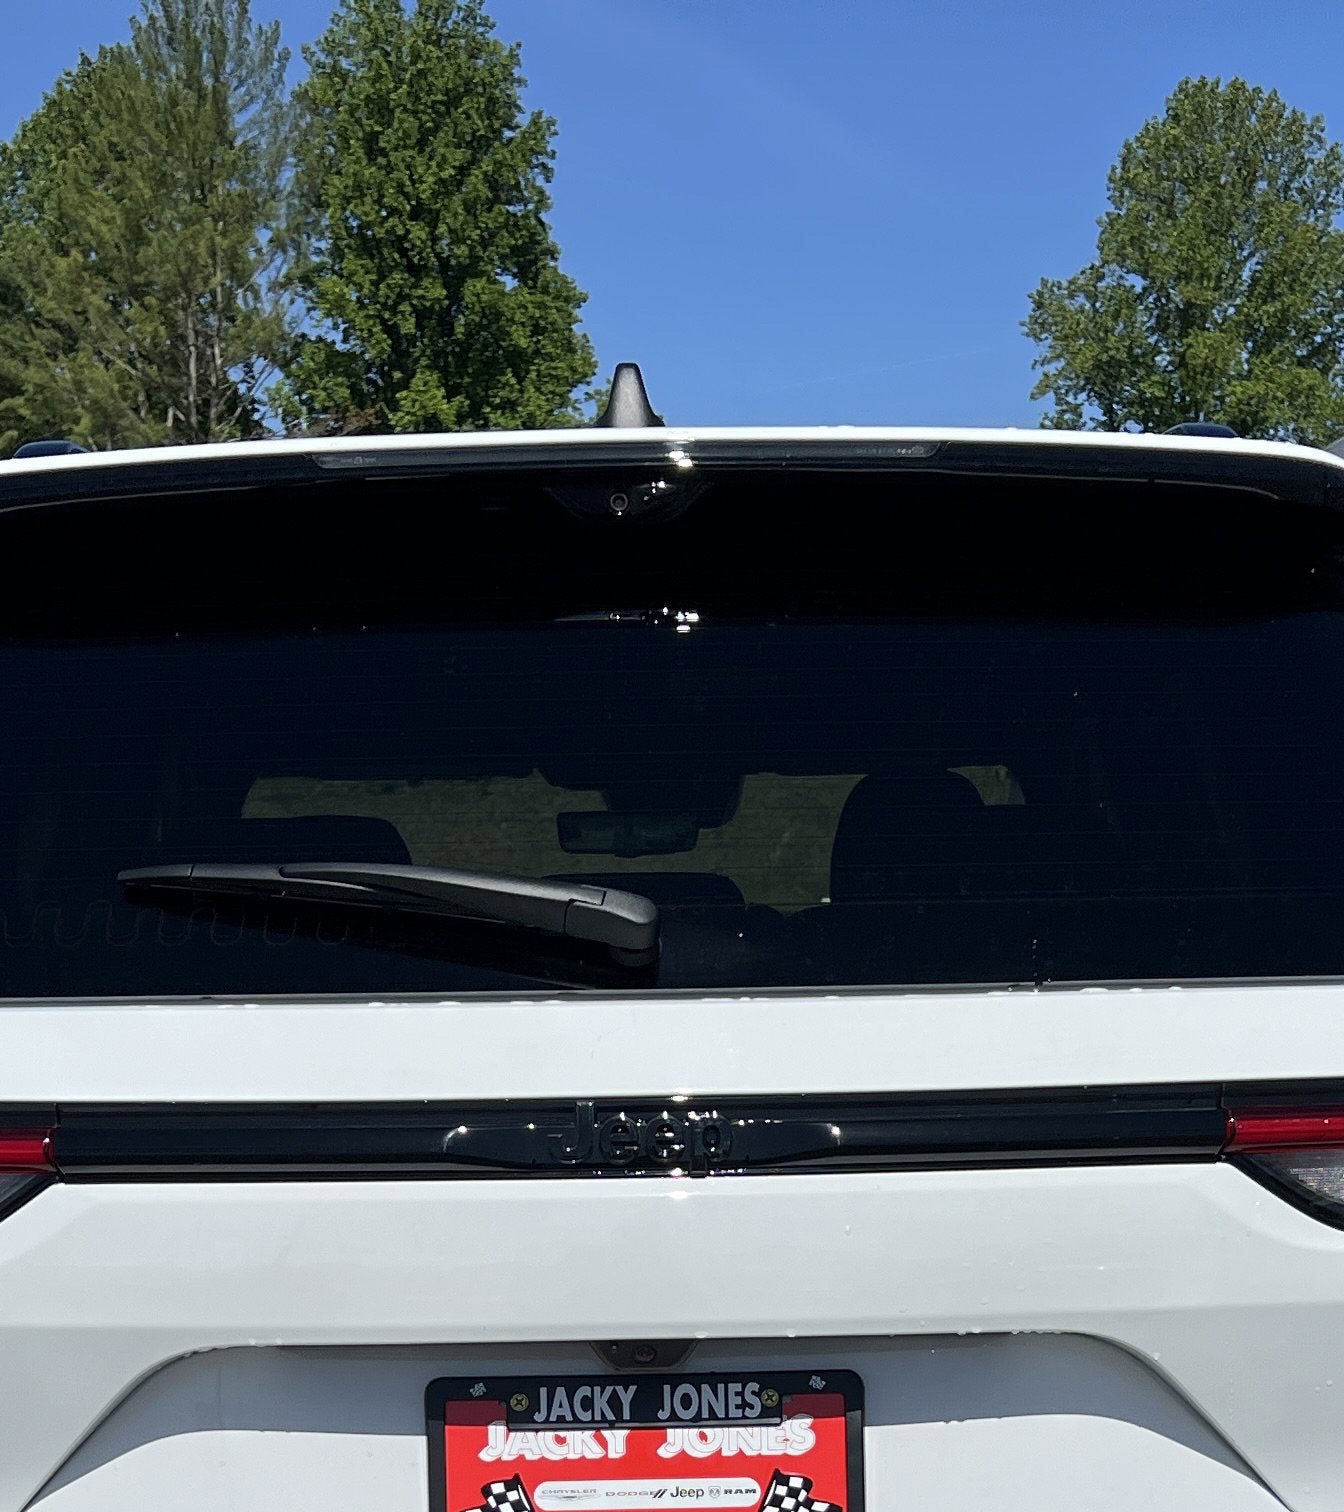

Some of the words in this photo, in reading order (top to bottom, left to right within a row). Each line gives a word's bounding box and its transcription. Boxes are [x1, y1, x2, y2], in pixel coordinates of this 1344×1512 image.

[549, 1100, 734, 1178] Jeep
[534, 1385, 637, 1423] JACKY
[657, 1382, 762, 1420] JONES
[478, 1421, 631, 1462] JACKY
[656, 1413, 816, 1459] JONES
[541, 1487, 597, 1496] CHRYSLER
[670, 1486, 704, 1499] Jeep
